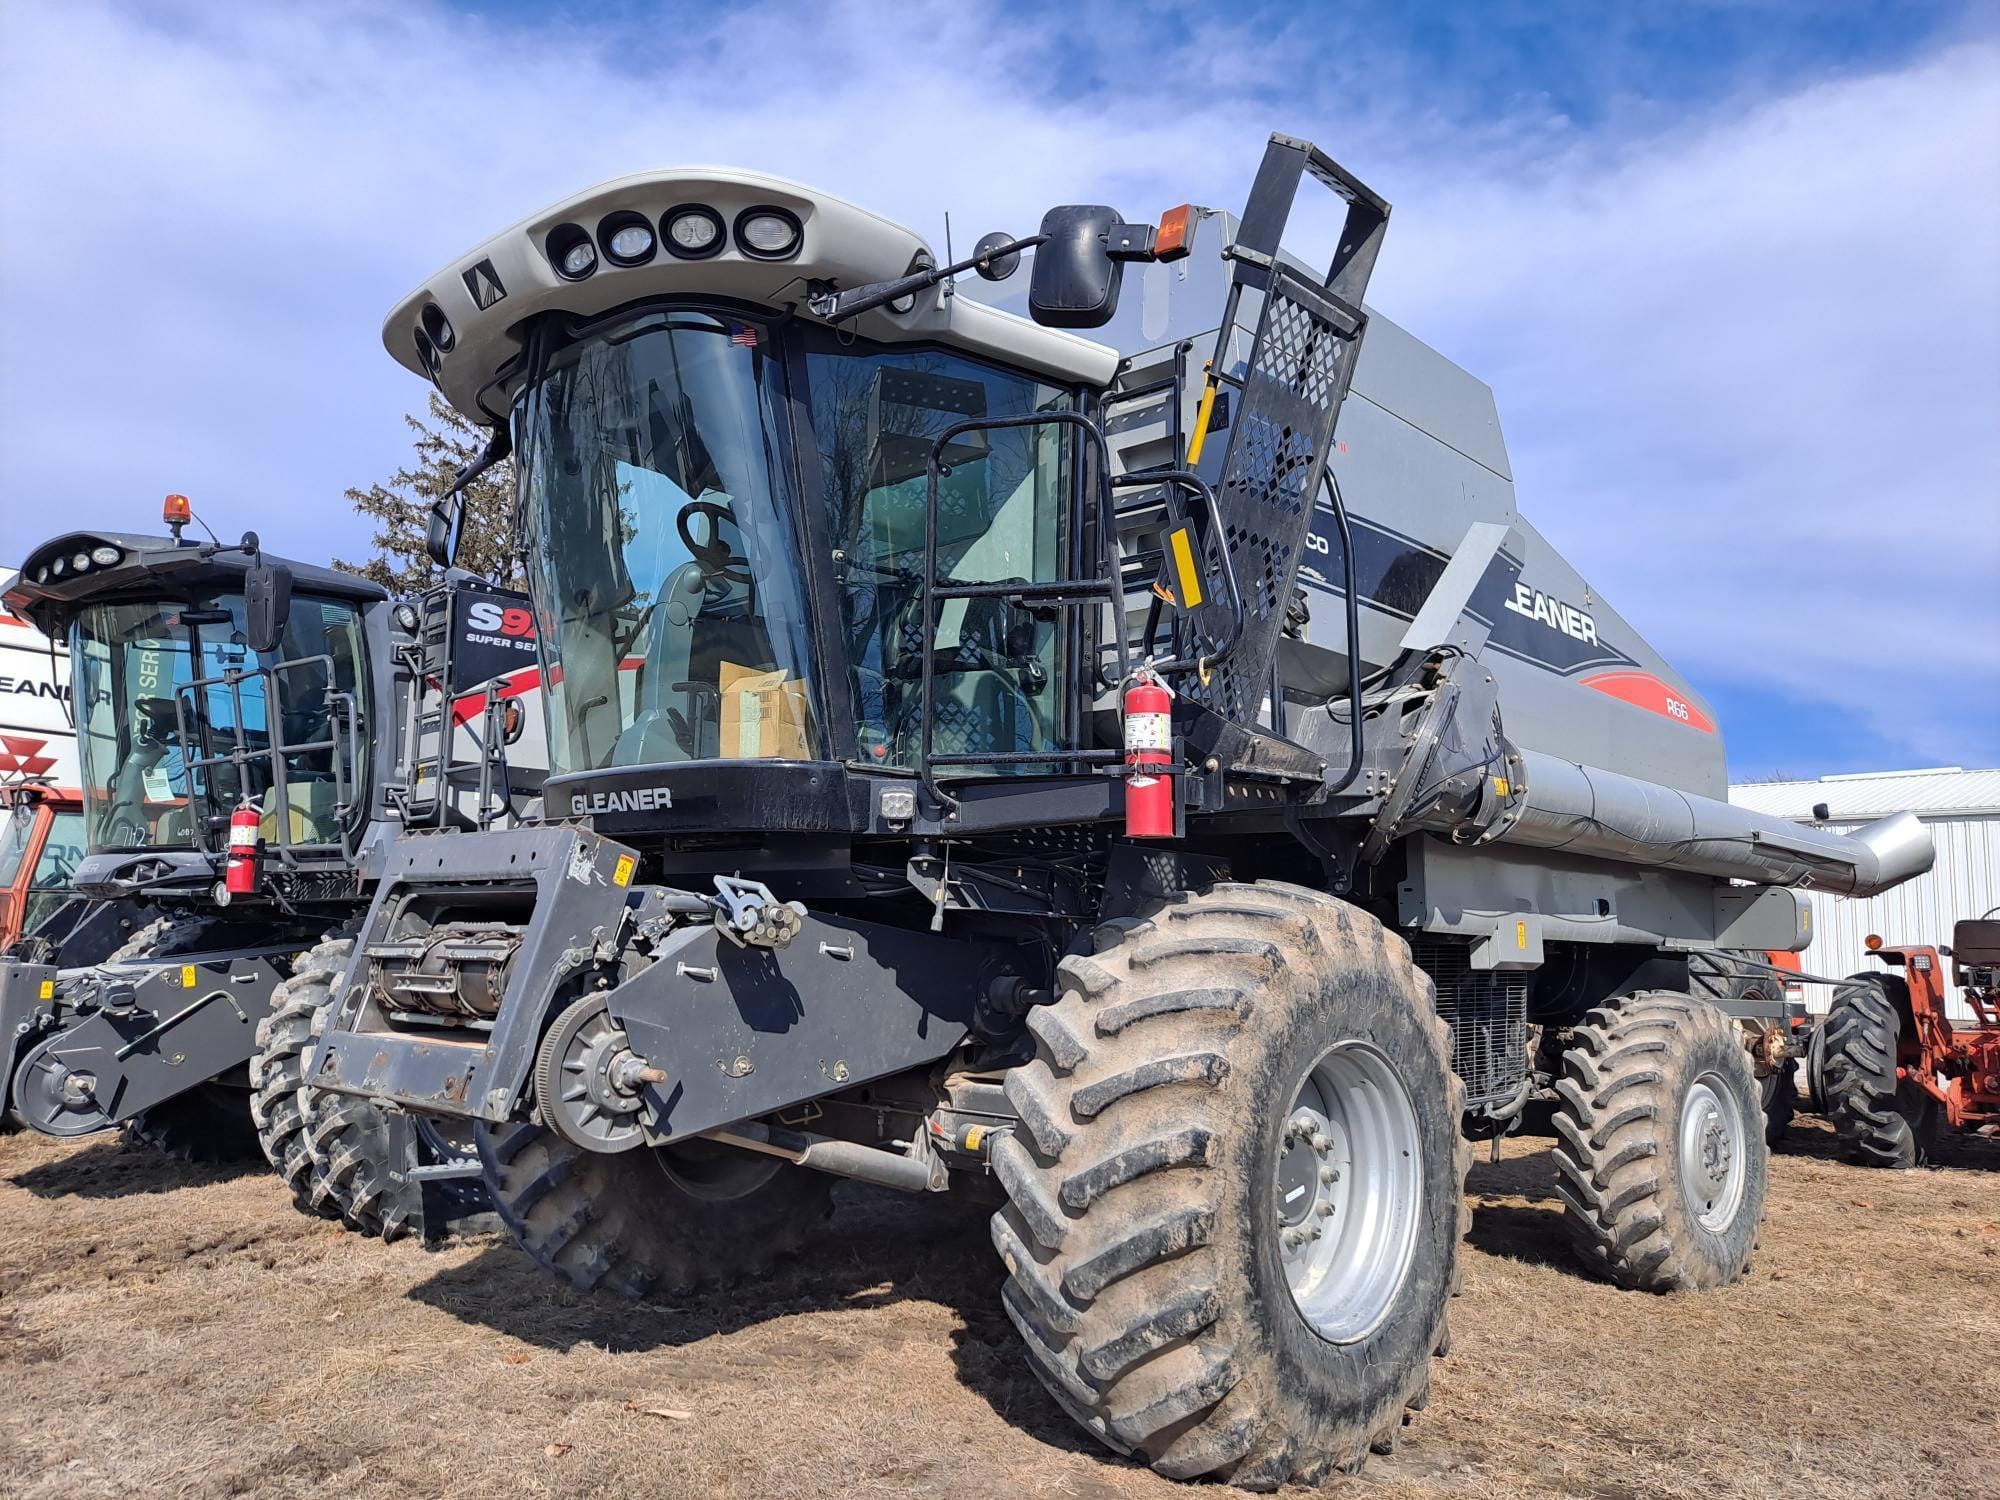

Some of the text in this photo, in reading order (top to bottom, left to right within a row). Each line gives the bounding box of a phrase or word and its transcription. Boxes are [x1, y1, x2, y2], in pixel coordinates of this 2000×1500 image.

[466, 633, 511, 648] SUPER
[1665, 697, 1689, 721] R66
[571, 787, 673, 815] GLEANER
